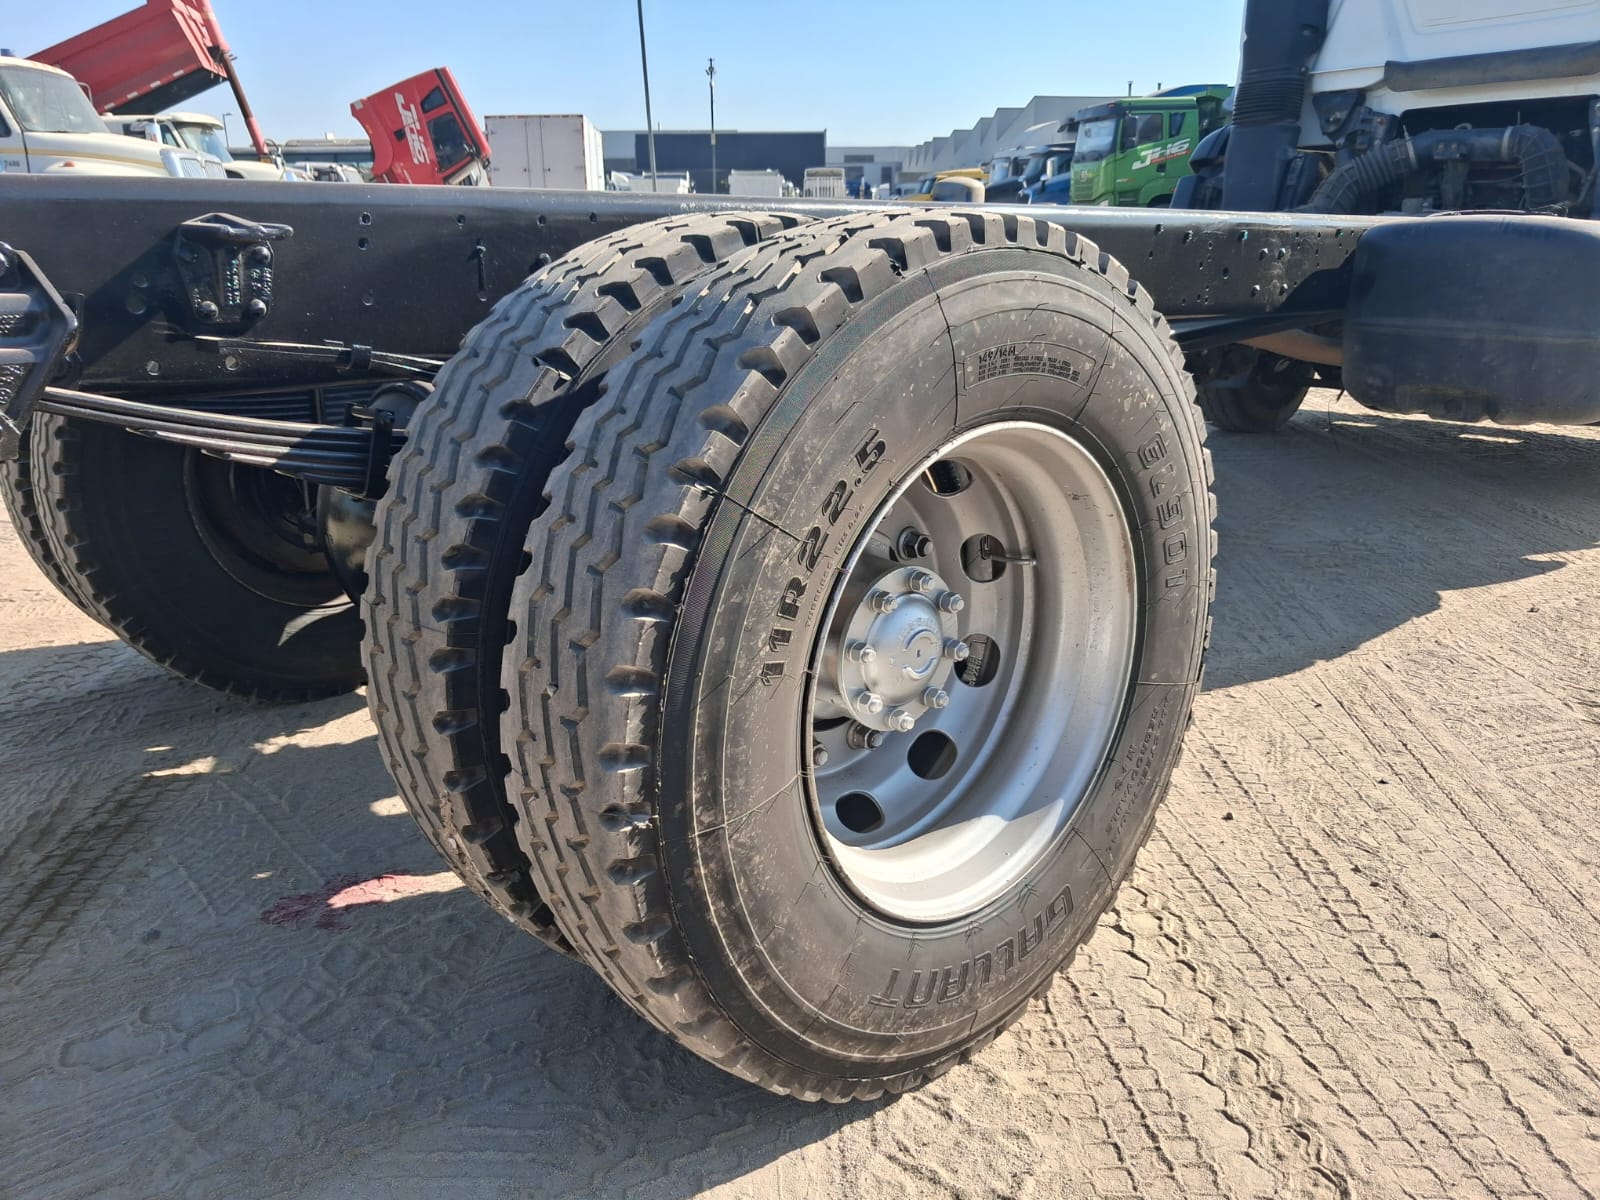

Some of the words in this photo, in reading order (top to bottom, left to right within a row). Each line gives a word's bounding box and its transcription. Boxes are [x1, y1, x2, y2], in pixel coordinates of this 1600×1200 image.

[1131, 138, 1191, 170] JH6
[761, 428, 886, 686] 11R22.5
[868, 884, 1075, 1010] GALLANT
